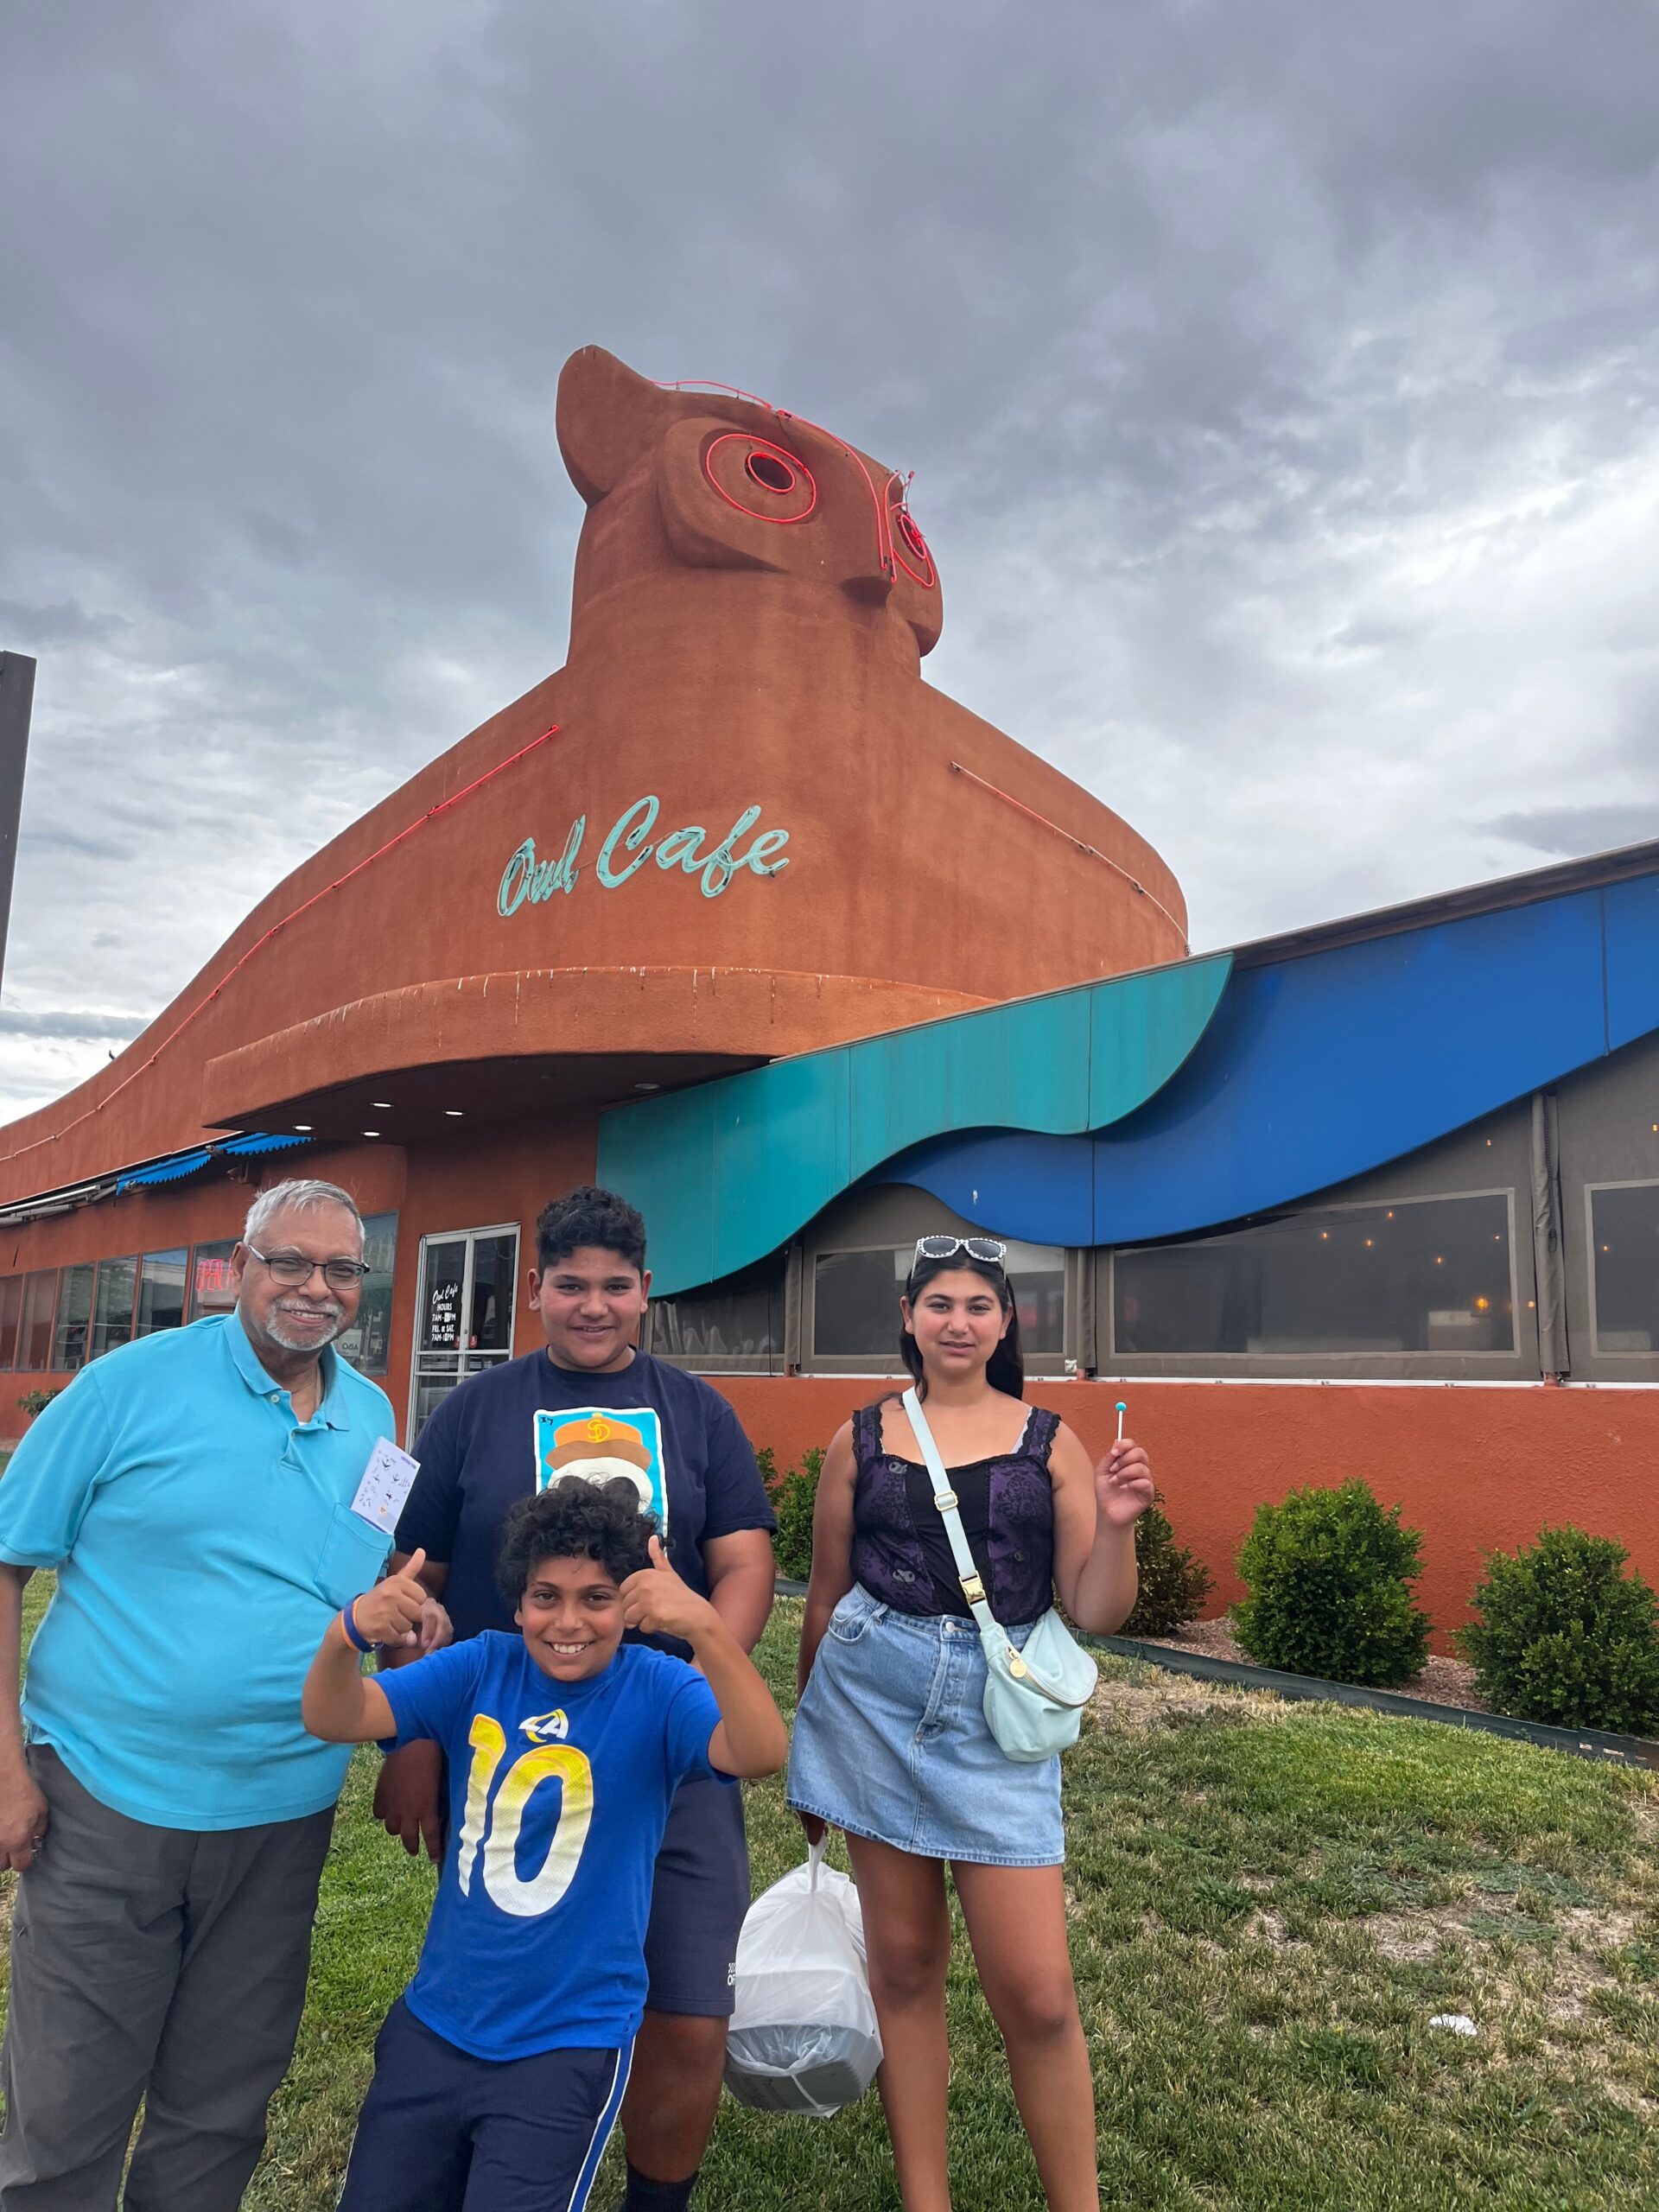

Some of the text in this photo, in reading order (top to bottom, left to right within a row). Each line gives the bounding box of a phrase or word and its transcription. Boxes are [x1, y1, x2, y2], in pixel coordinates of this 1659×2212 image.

[497, 795, 790, 916] Owl Cafe
[433, 1282, 458, 1304] Owl Cafe
[588, 1419, 610, 1443] SD
[458, 1713, 594, 1916] 10
